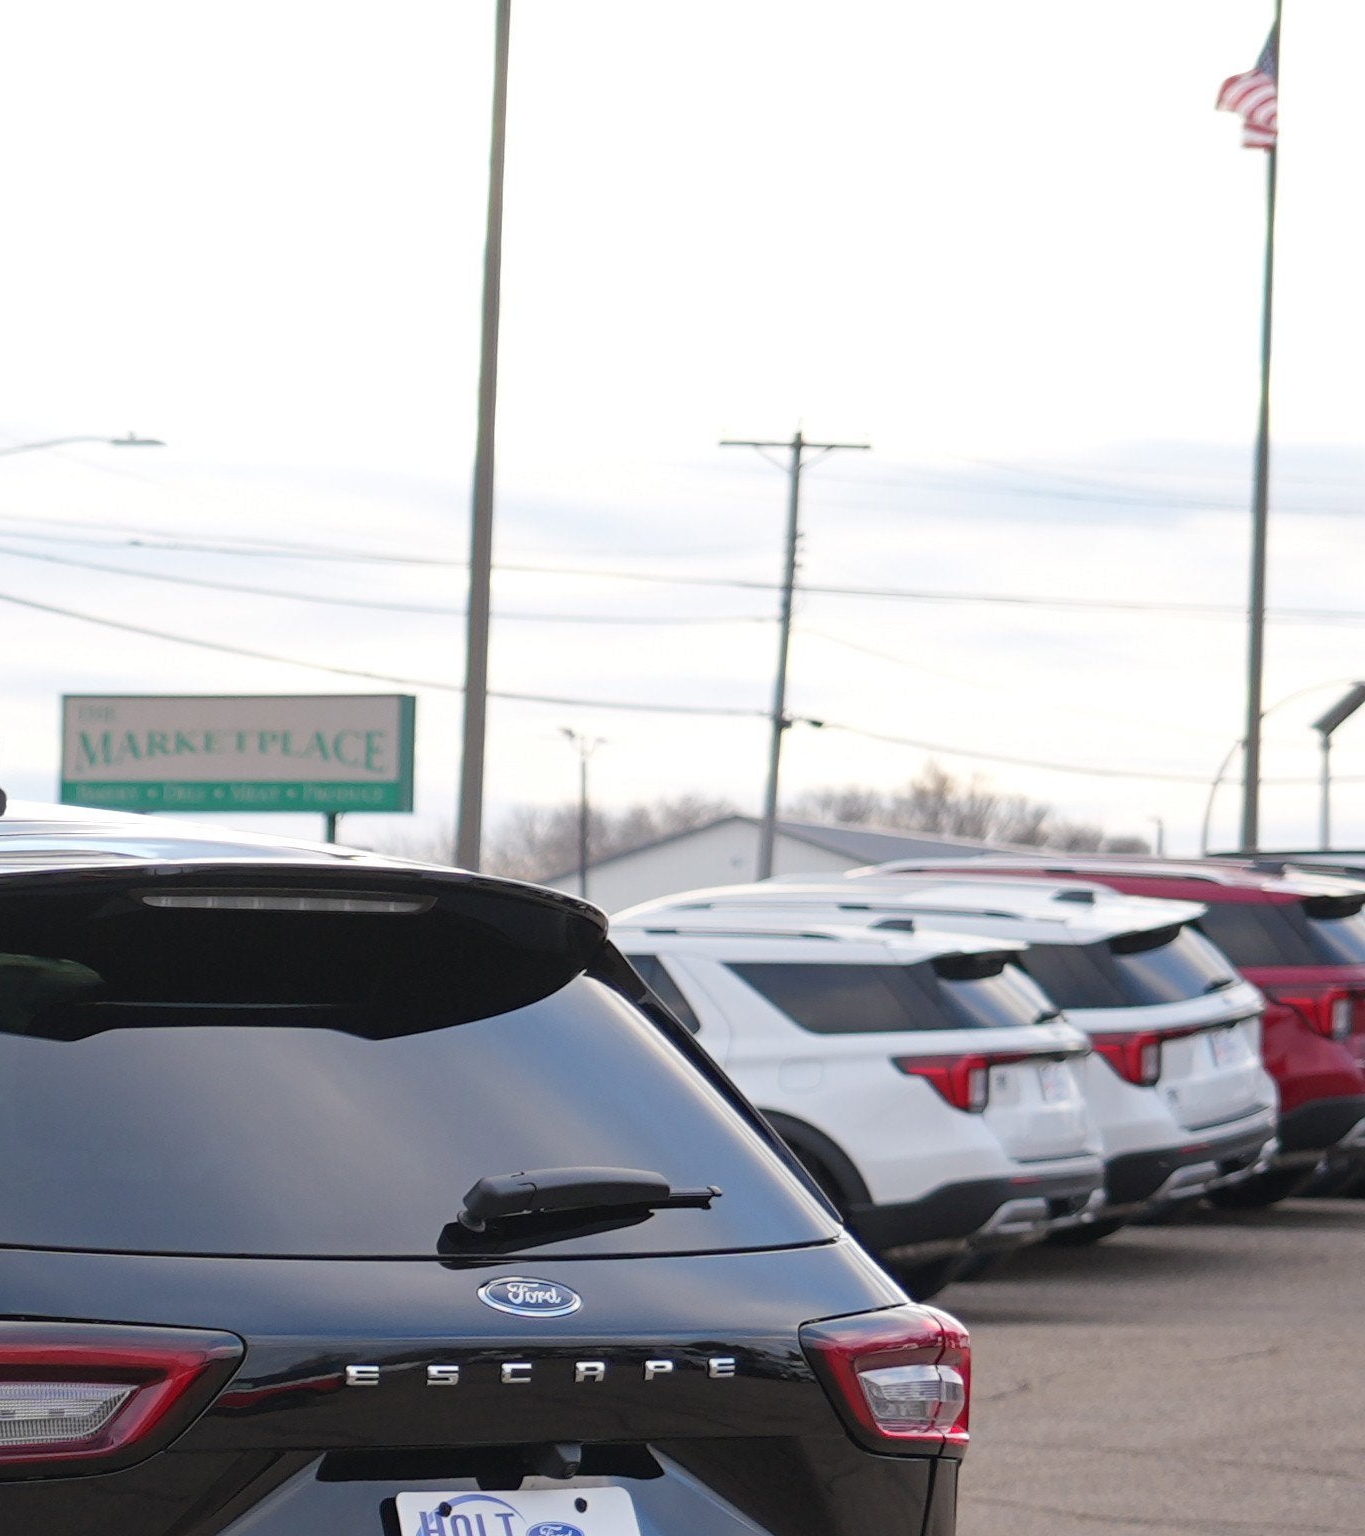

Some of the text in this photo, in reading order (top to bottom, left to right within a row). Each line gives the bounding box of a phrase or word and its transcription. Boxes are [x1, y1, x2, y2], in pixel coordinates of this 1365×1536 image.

[75, 727, 385, 773] MARKETPLACE
[506, 1282, 561, 1304] Ford
[346, 1358, 735, 1386] ESCAPE
